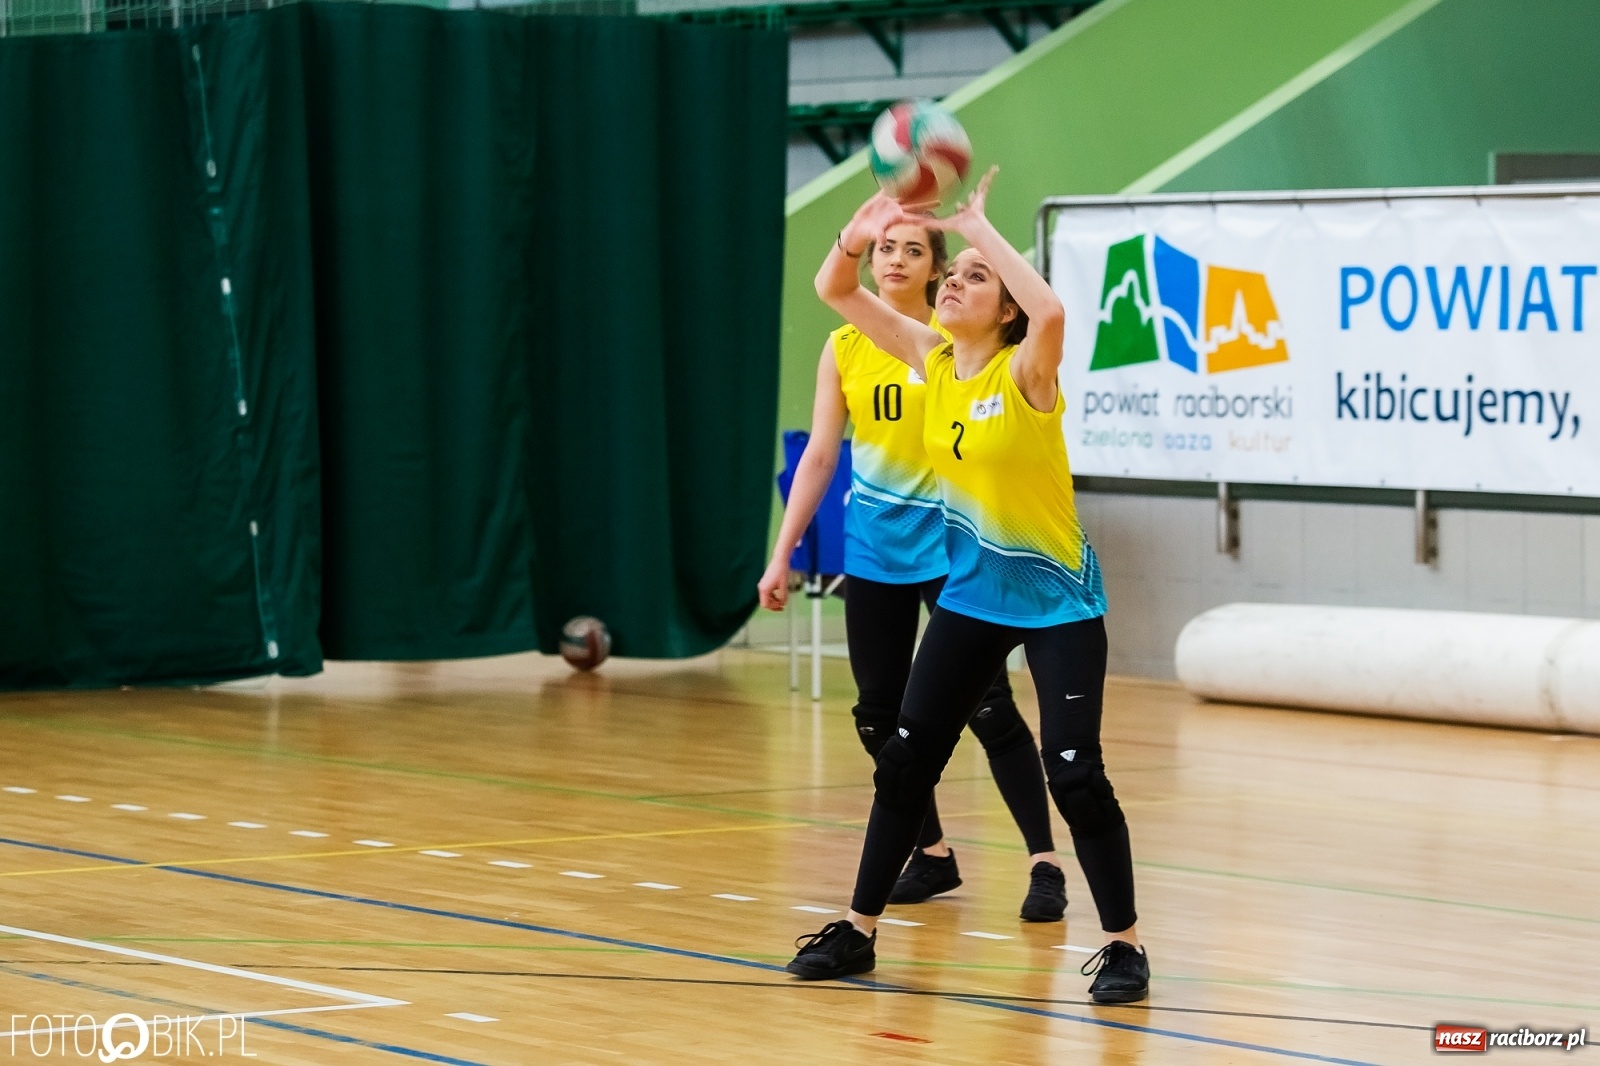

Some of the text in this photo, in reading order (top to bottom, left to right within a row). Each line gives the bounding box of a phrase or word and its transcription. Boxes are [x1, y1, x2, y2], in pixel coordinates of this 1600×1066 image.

[1340, 265, 1598, 331] POWIAT
[873, 383, 902, 421] 10
[1083, 384, 1293, 422] powiat raciborski
[1336, 371, 1581, 440] kibicujemy,
[951, 421, 965, 460] 2
[1081, 427, 1152, 448] zielona
[1227, 430, 1291, 452] kultur
